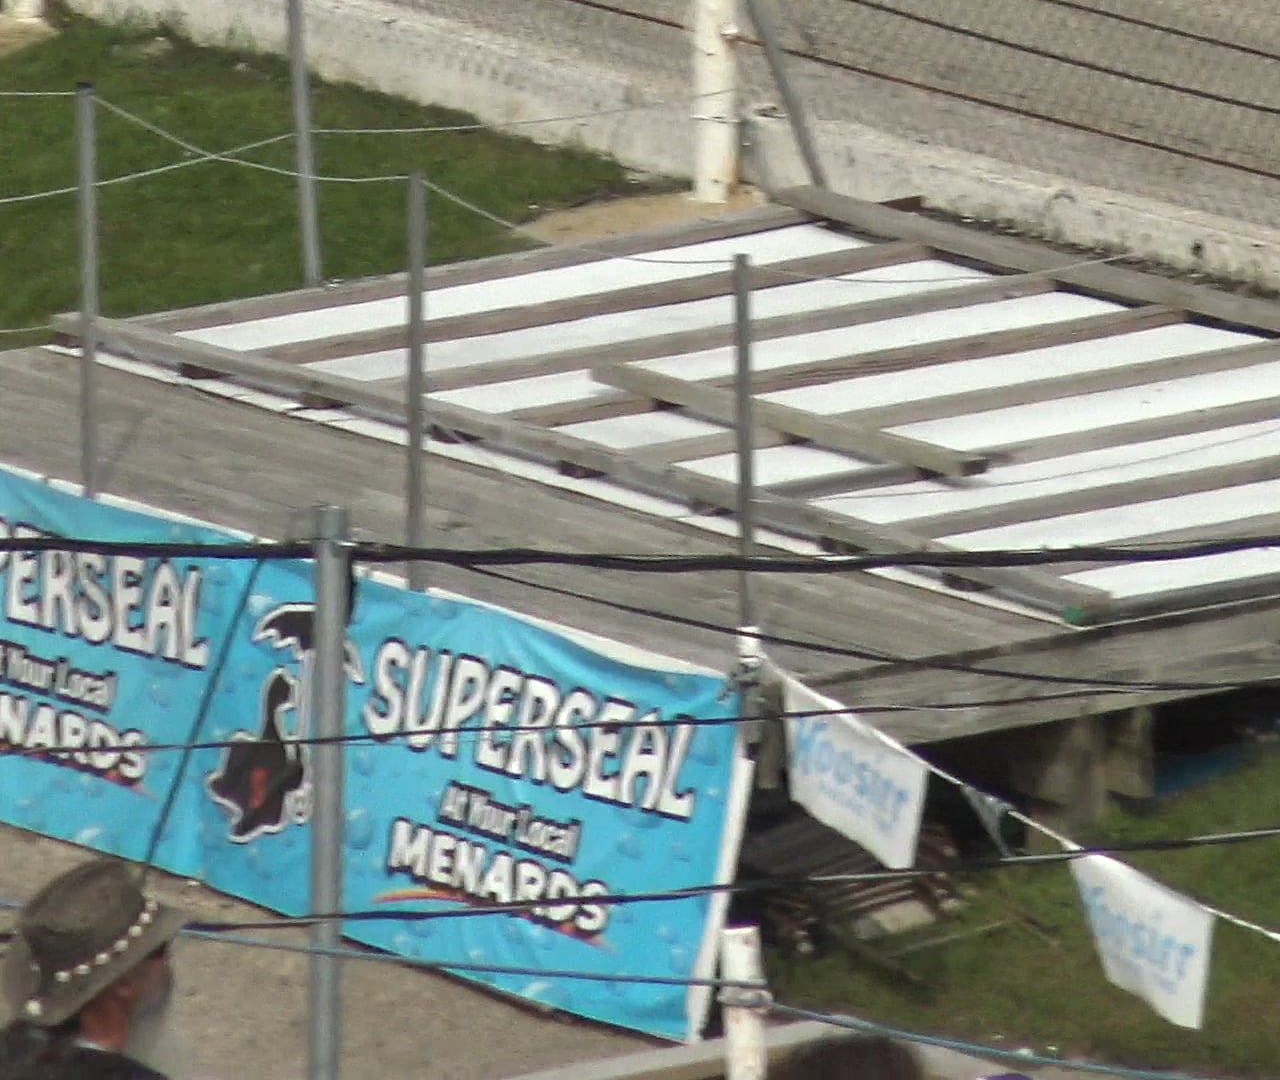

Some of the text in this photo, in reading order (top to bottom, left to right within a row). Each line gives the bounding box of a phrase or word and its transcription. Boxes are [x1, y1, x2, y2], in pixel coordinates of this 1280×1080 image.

[54, 657, 118, 715] Local
[364, 636, 697, 823] SUPERSEAL
[387, 816, 610, 933] MENARDS
[514, 803, 583, 865] Local
